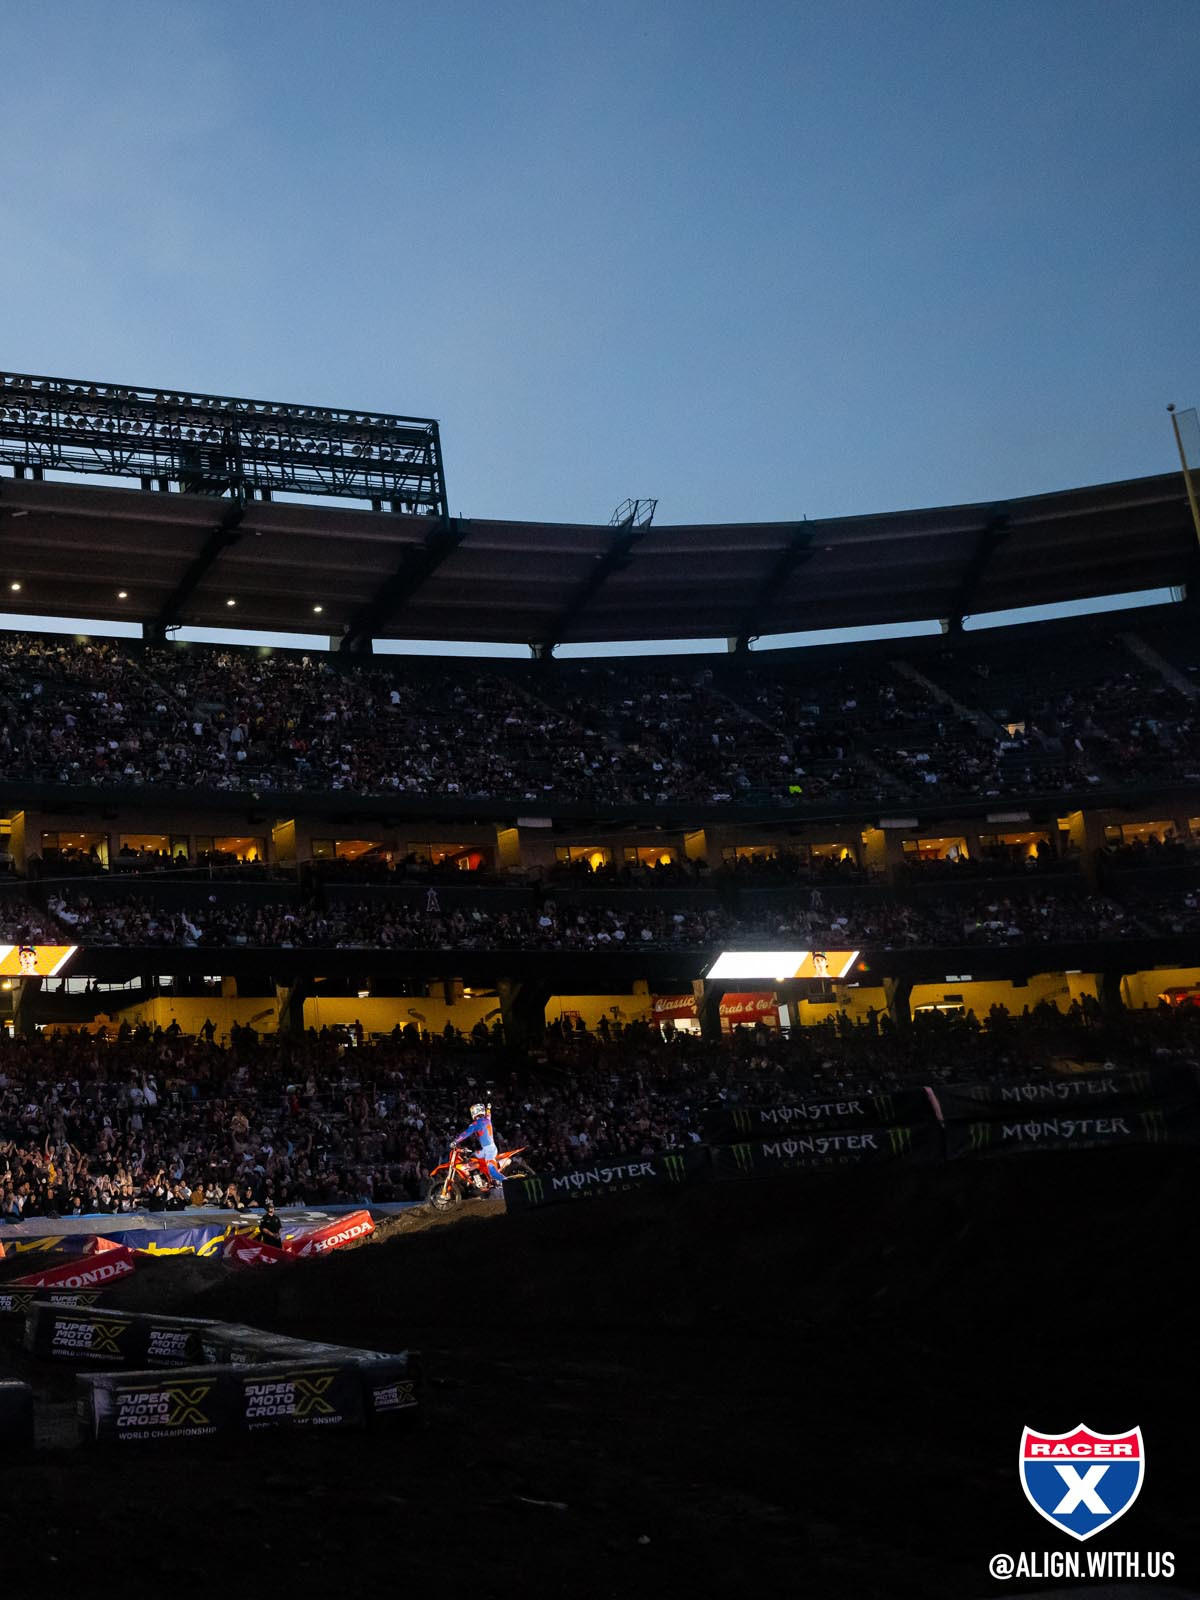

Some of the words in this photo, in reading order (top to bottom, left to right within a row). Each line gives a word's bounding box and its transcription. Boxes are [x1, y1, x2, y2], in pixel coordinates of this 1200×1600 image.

[655, 998, 695, 1013] Classic
[720, 1003, 743, 1015] Grab
[1001, 1079, 1119, 1102] MONSTER
[760, 1101, 864, 1124] MONSTER
[1002, 1117, 1131, 1141] MONSTER
[763, 1134, 879, 1158] MONSTER
[552, 1162, 656, 1190] MONSTER
[314, 1222, 373, 1252] HONDA
[55, 1321, 96, 1333] SUPER
[56, 1330, 92, 1340] MOTO
[149, 1332, 190, 1342] SUPER
[52, 1337, 93, 1348] CROSS
[244, 1383, 296, 1397] SUPER
[116, 1392, 170, 1405] SUPER
[248, 1394, 295, 1406] MOTO
[120, 1403, 169, 1415] MOTO
[246, 1404, 296, 1418] CROSS
[117, 1414, 170, 1427] CROSS
[119, 1430, 150, 1440] WORLD
[151, 1426, 217, 1438] CHAMPIONSHIP
